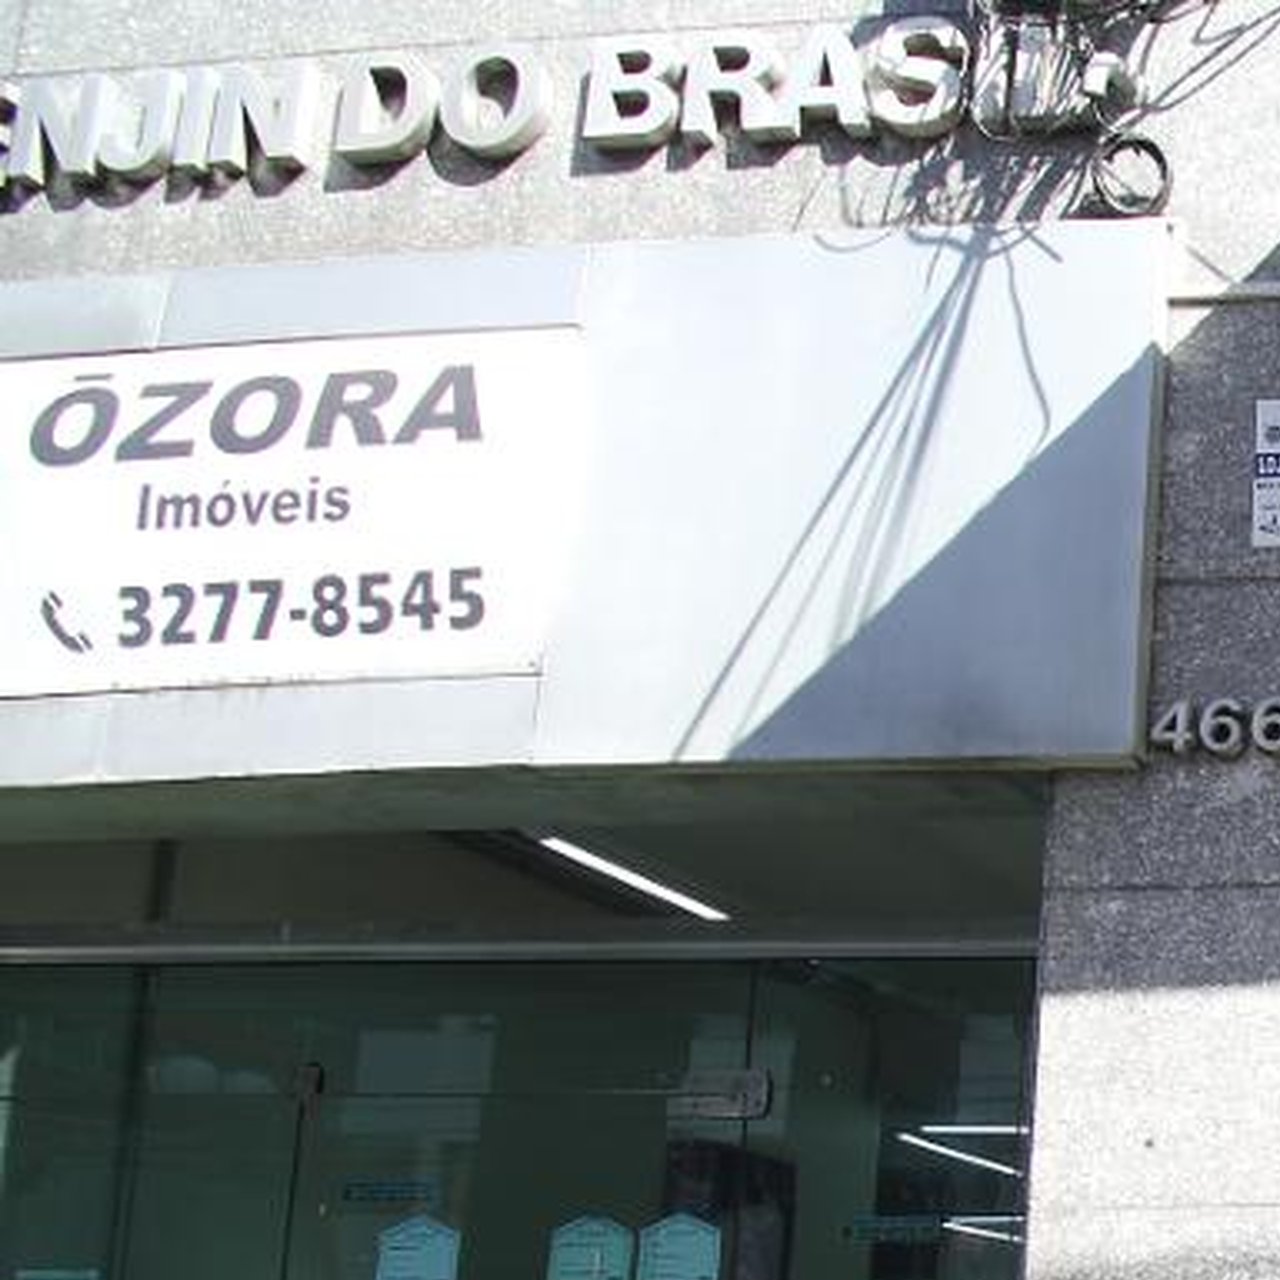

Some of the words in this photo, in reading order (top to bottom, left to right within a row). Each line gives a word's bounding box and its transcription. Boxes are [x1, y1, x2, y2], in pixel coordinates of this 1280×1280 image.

[335, 44, 550, 166] DO
[136, 477, 351, 530] Imóveis
[117, 566, 486, 648] 3277-8545
